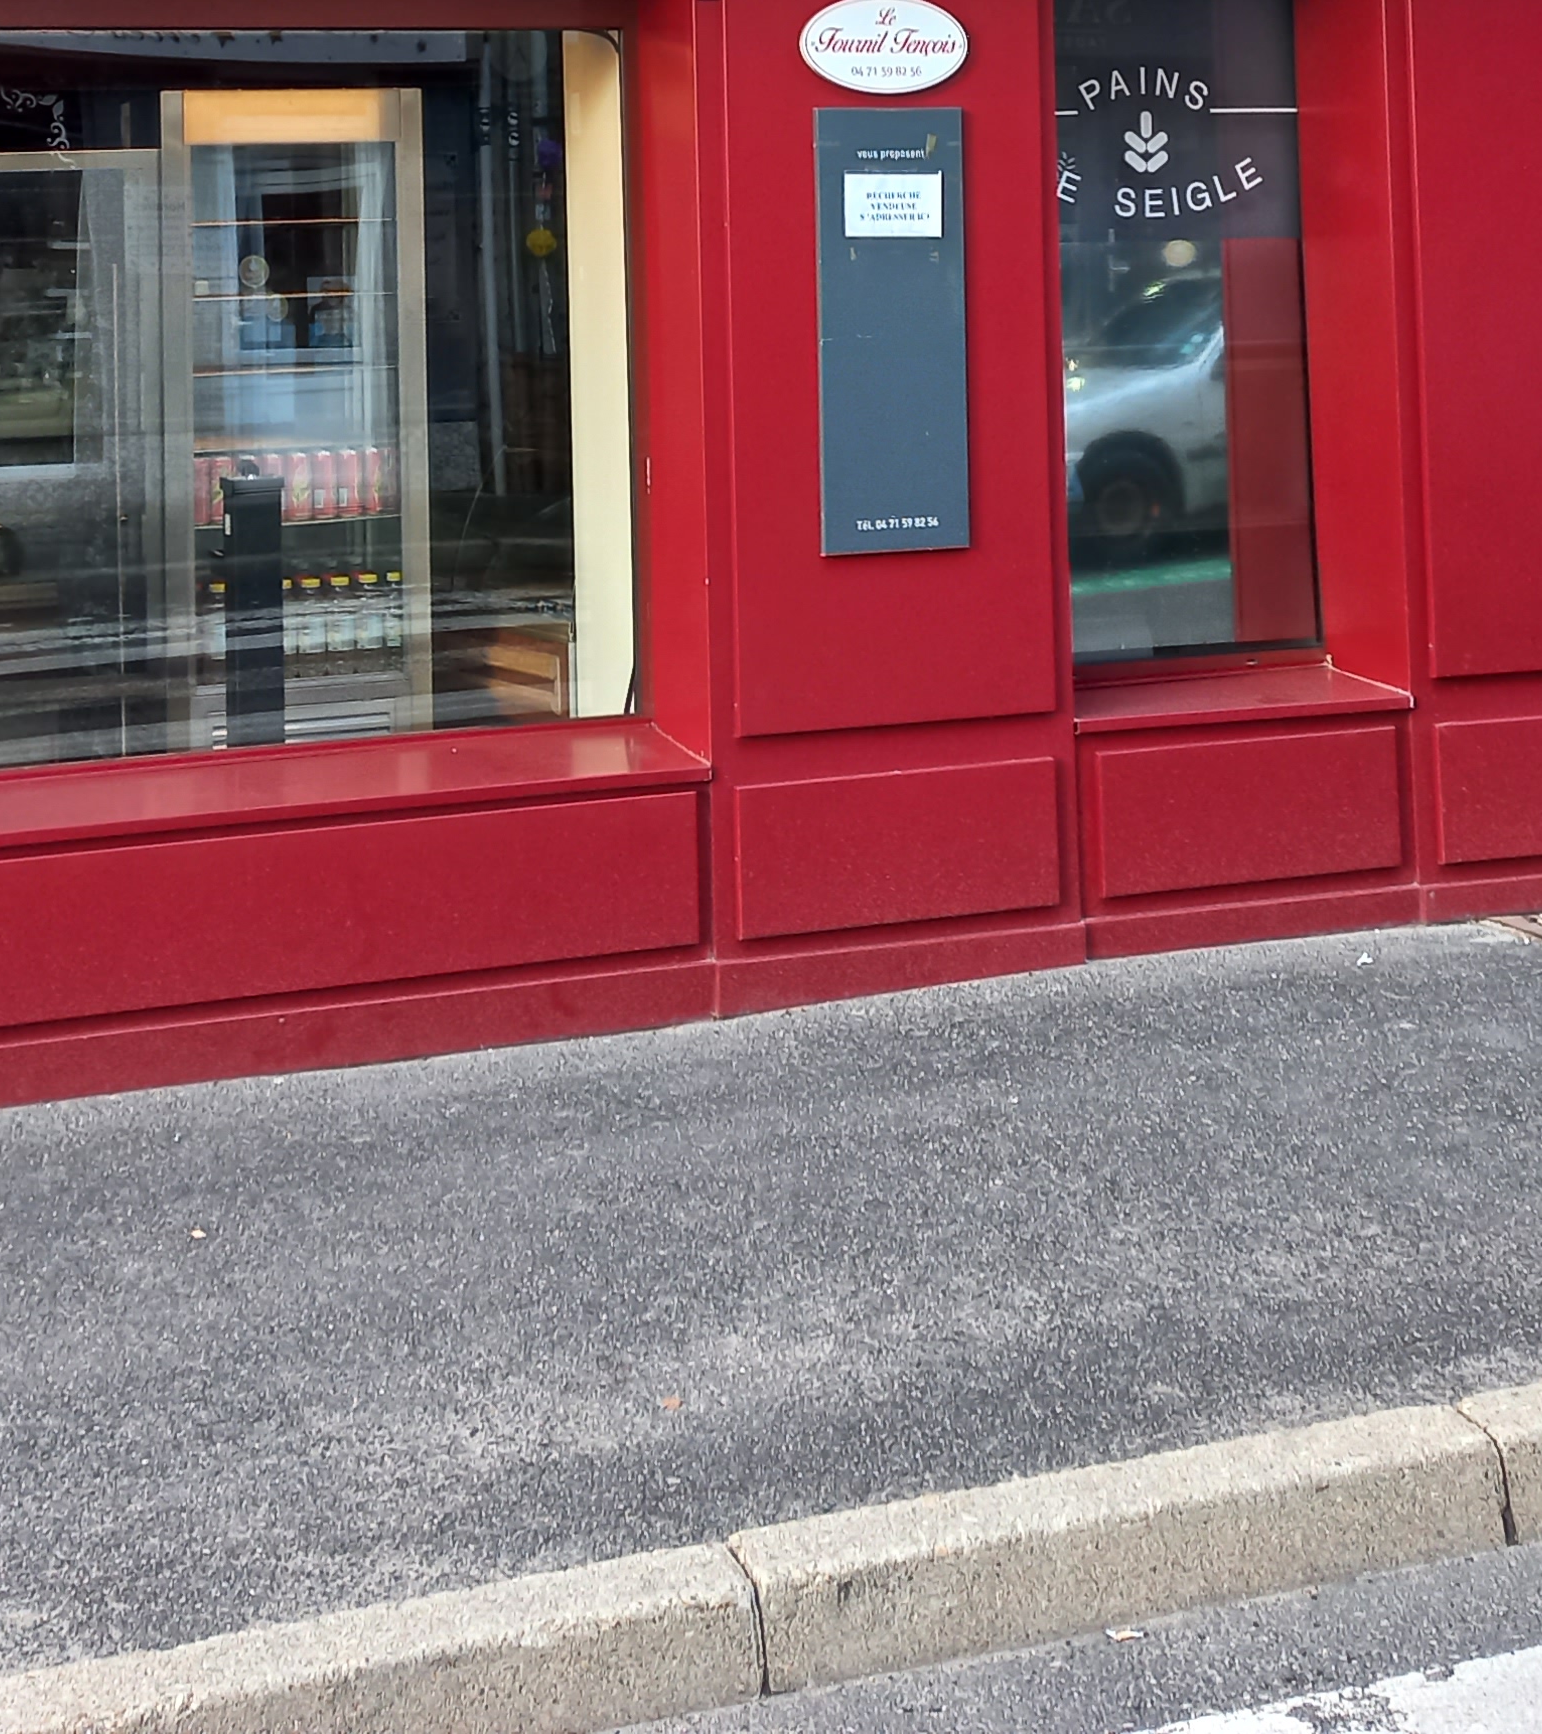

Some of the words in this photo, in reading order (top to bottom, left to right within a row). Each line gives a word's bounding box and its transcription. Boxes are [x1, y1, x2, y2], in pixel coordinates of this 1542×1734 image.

[875, 7, 897, 26] Le
[815, 27, 889, 54] Fournil
[890, 28, 956, 57] Tençois
[851, 66, 863, 77] 04
[867, 67, 878, 77] 71
[881, 66, 893, 77] 59
[910, 66, 922, 77] 56
[1078, 67, 1209, 110] PAINS
[1114, 157, 1263, 218] SEIGLE
[875, 519, 888, 530] 04
[888, 518, 899, 529] 71
[901, 517, 913, 528] 59
[914, 517, 926, 527] 82
[927, 516, 939, 527] 56
